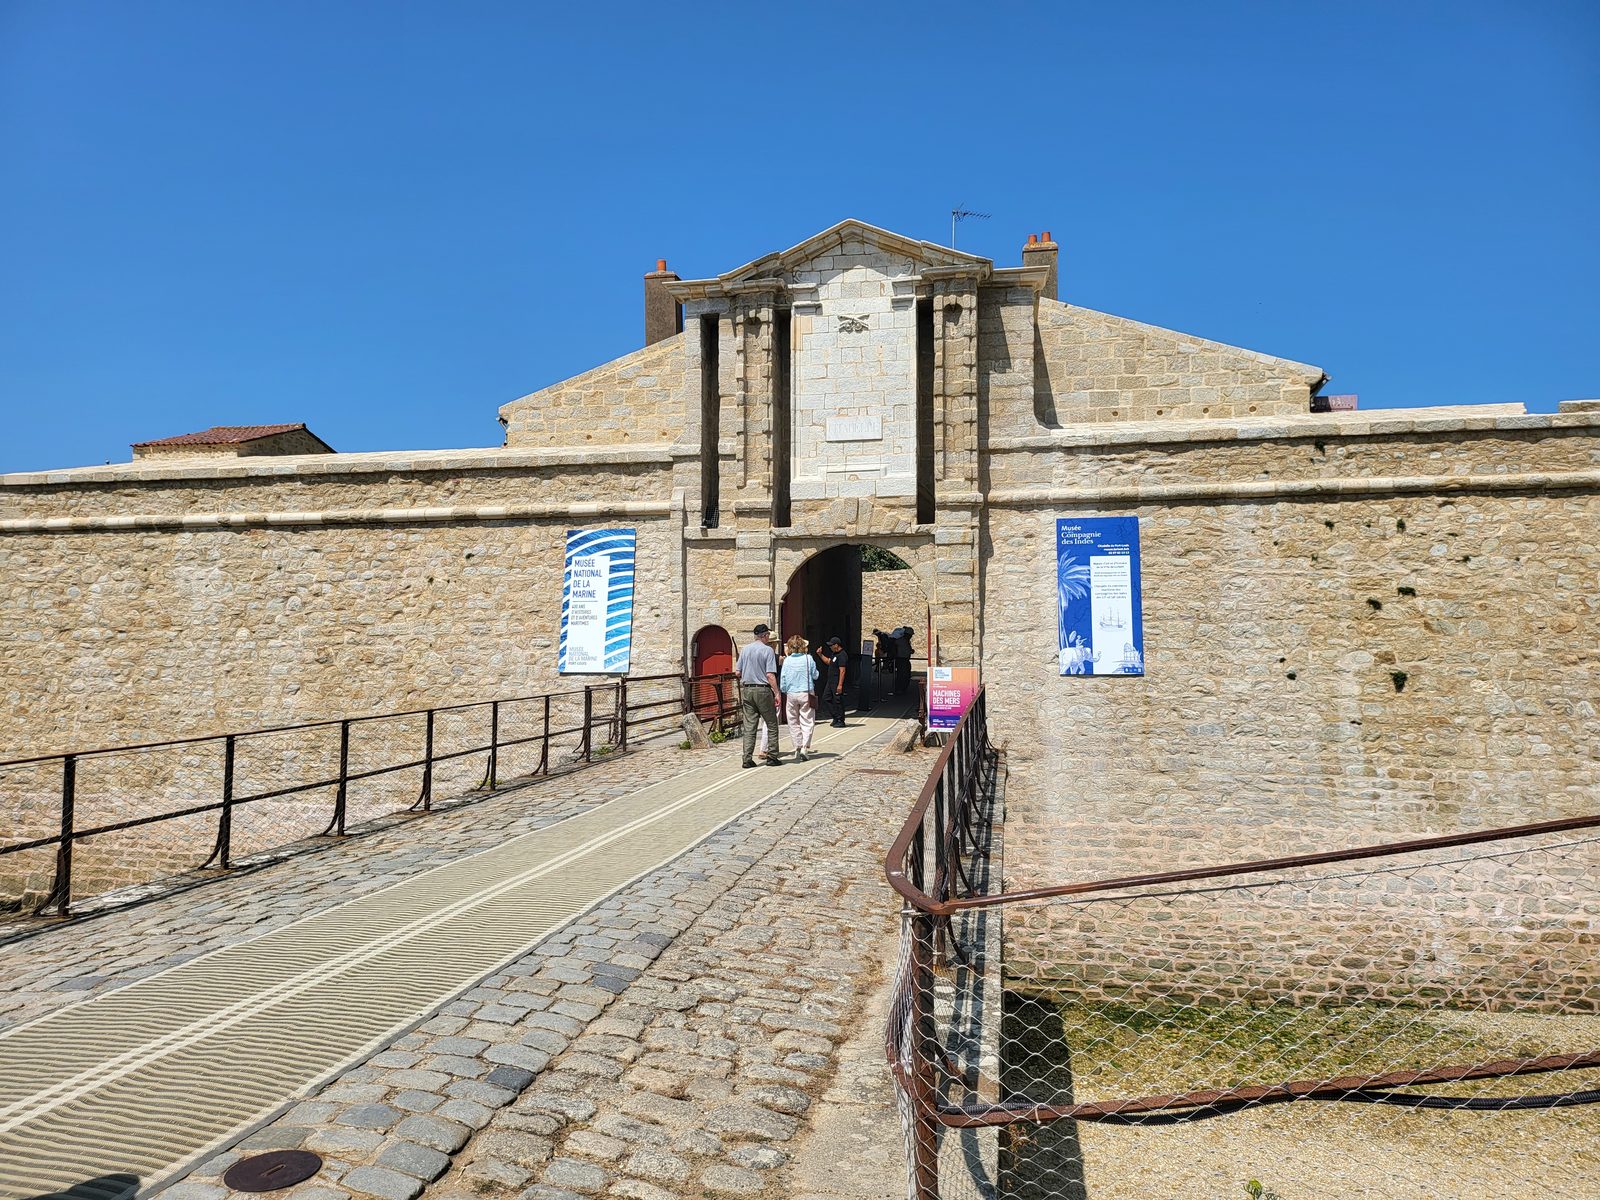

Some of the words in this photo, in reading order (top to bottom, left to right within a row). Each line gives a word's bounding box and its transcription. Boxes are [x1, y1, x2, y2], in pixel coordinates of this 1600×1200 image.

[1061, 531, 1102, 539] Compagnie
[574, 557, 596, 568] MUSÉE
[573, 569, 603, 578] NATIONAL
[572, 579, 582, 588] DE
[582, 579, 591, 588] LA
[572, 589, 597, 598] MARINE
[932, 689, 961, 698] MACHINES
[932, 697, 944, 705] DES
[944, 697, 961, 705] MERS
